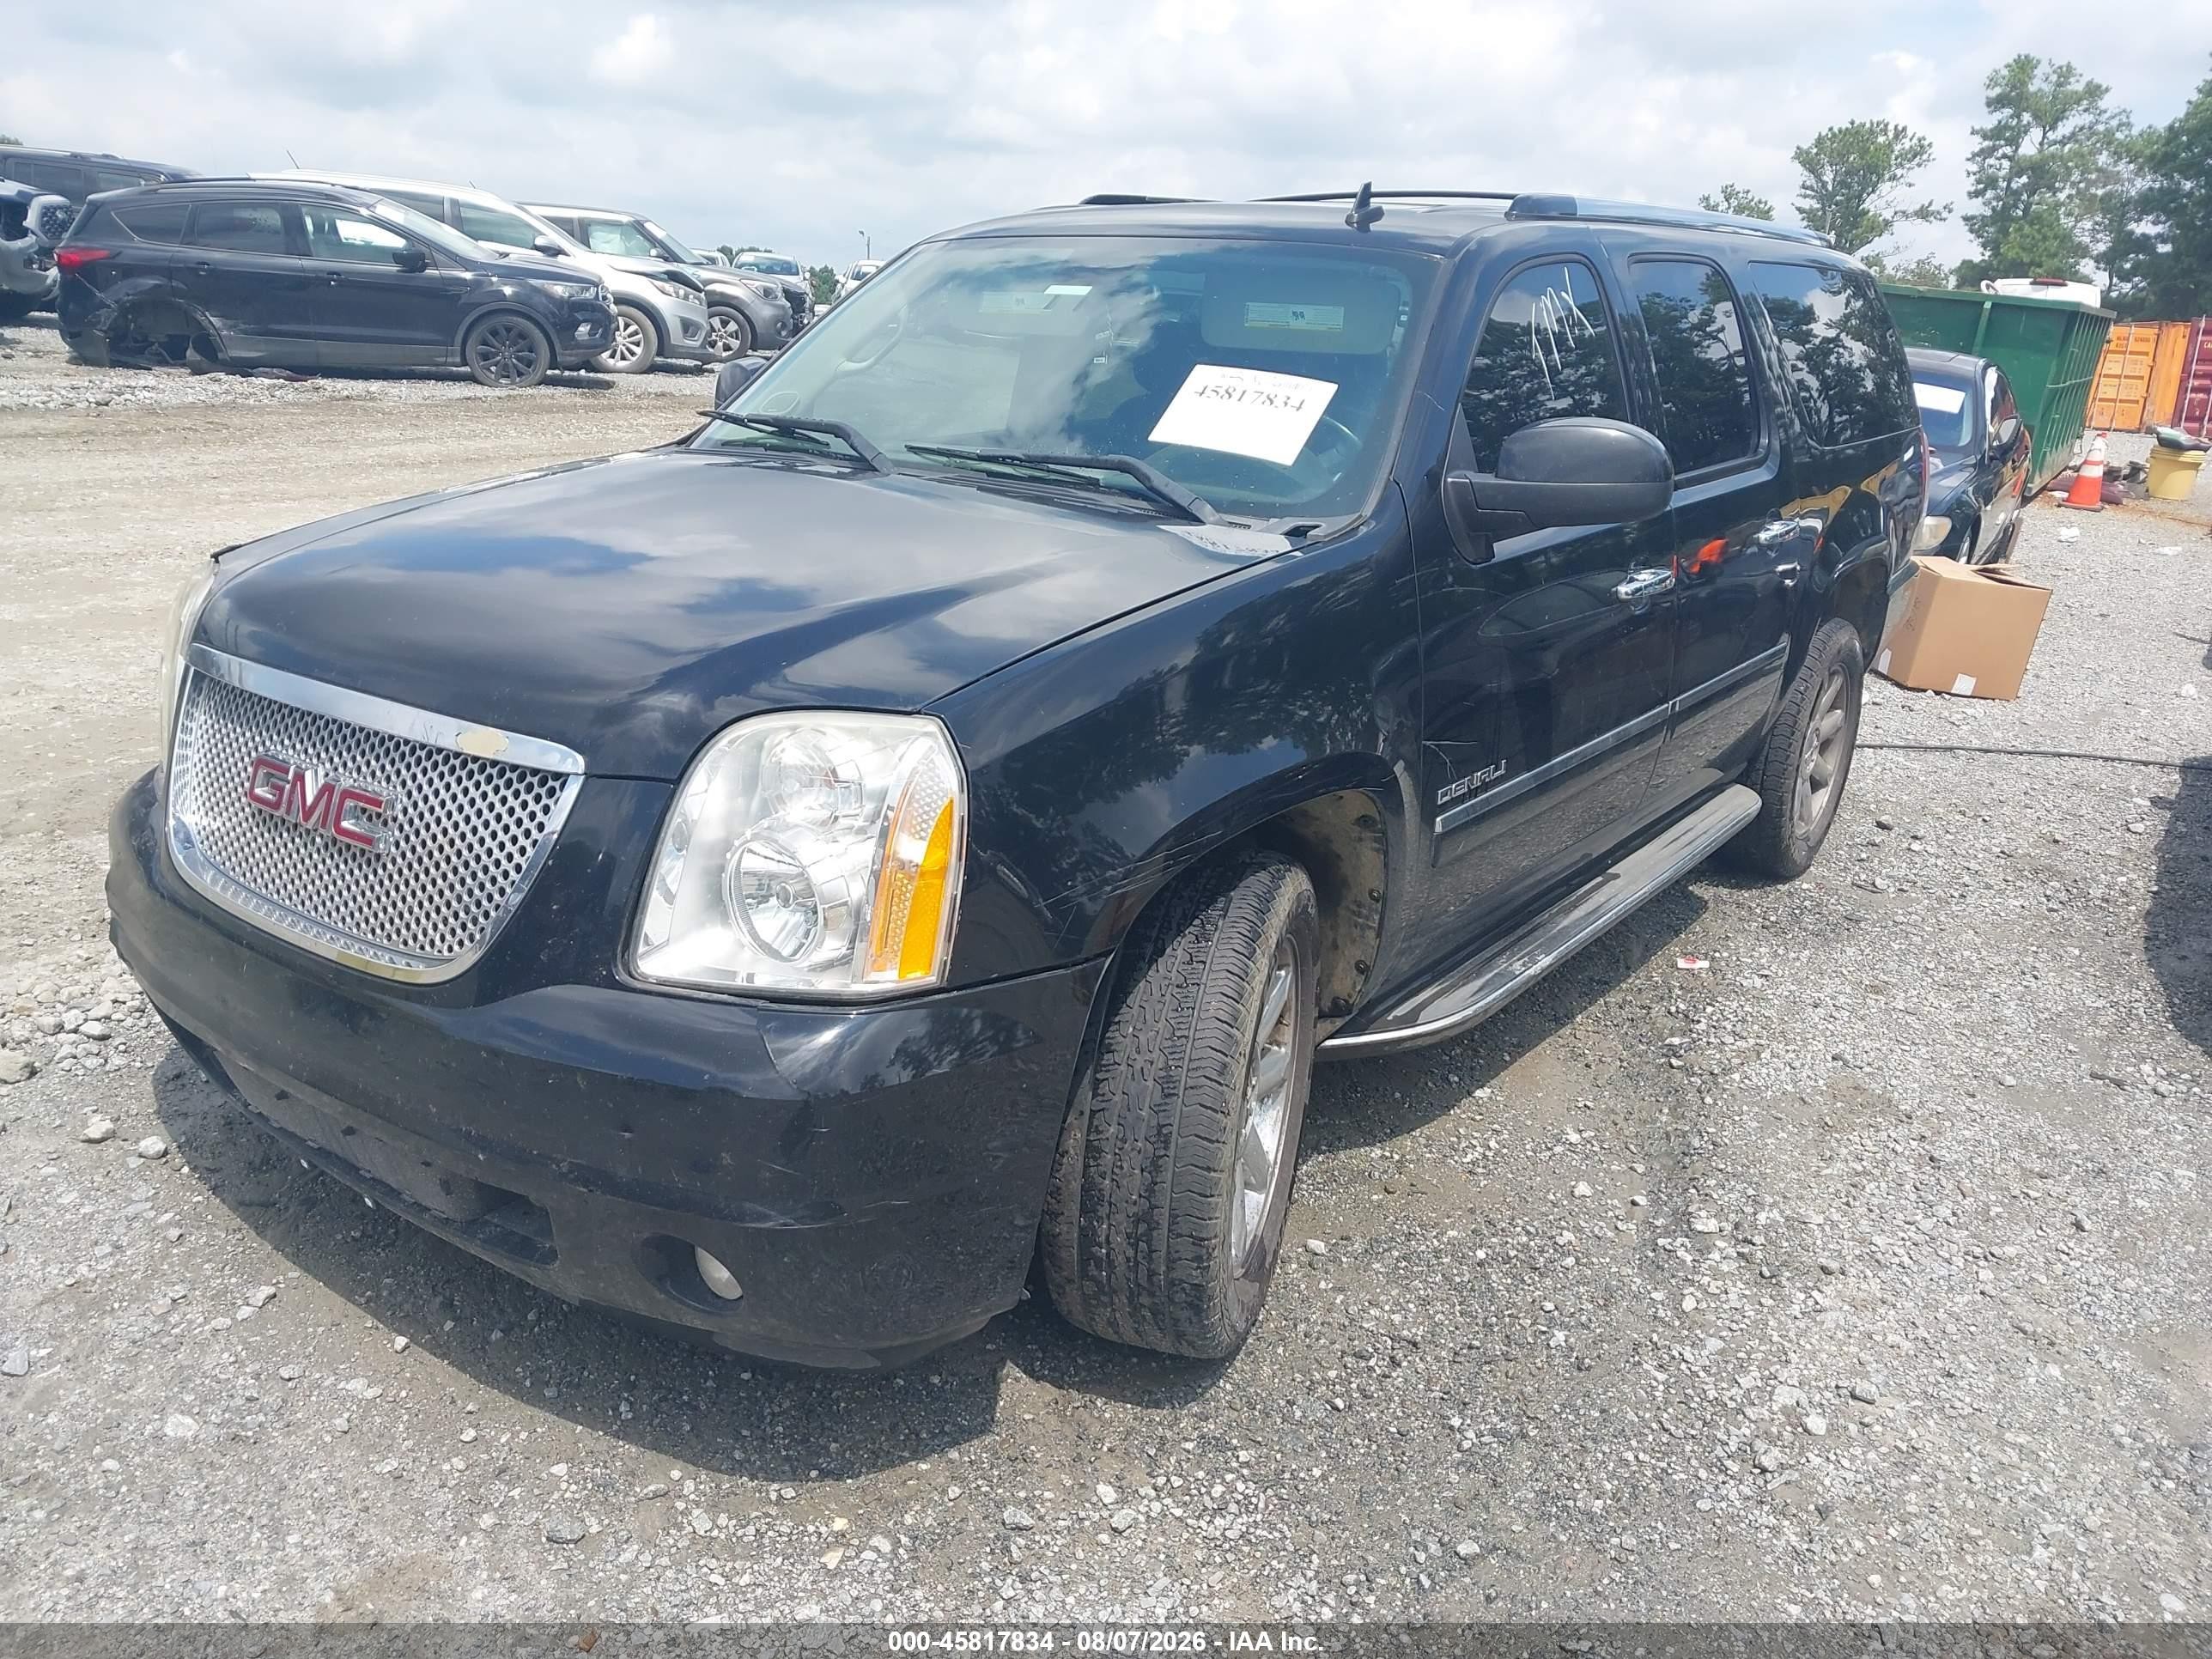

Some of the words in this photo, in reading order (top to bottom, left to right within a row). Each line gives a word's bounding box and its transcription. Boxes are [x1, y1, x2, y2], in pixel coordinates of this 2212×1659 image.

[1194, 384, 1306, 412] 45817834
[247, 755, 389, 853] GMC
[1437, 759, 1507, 805] DENALI
